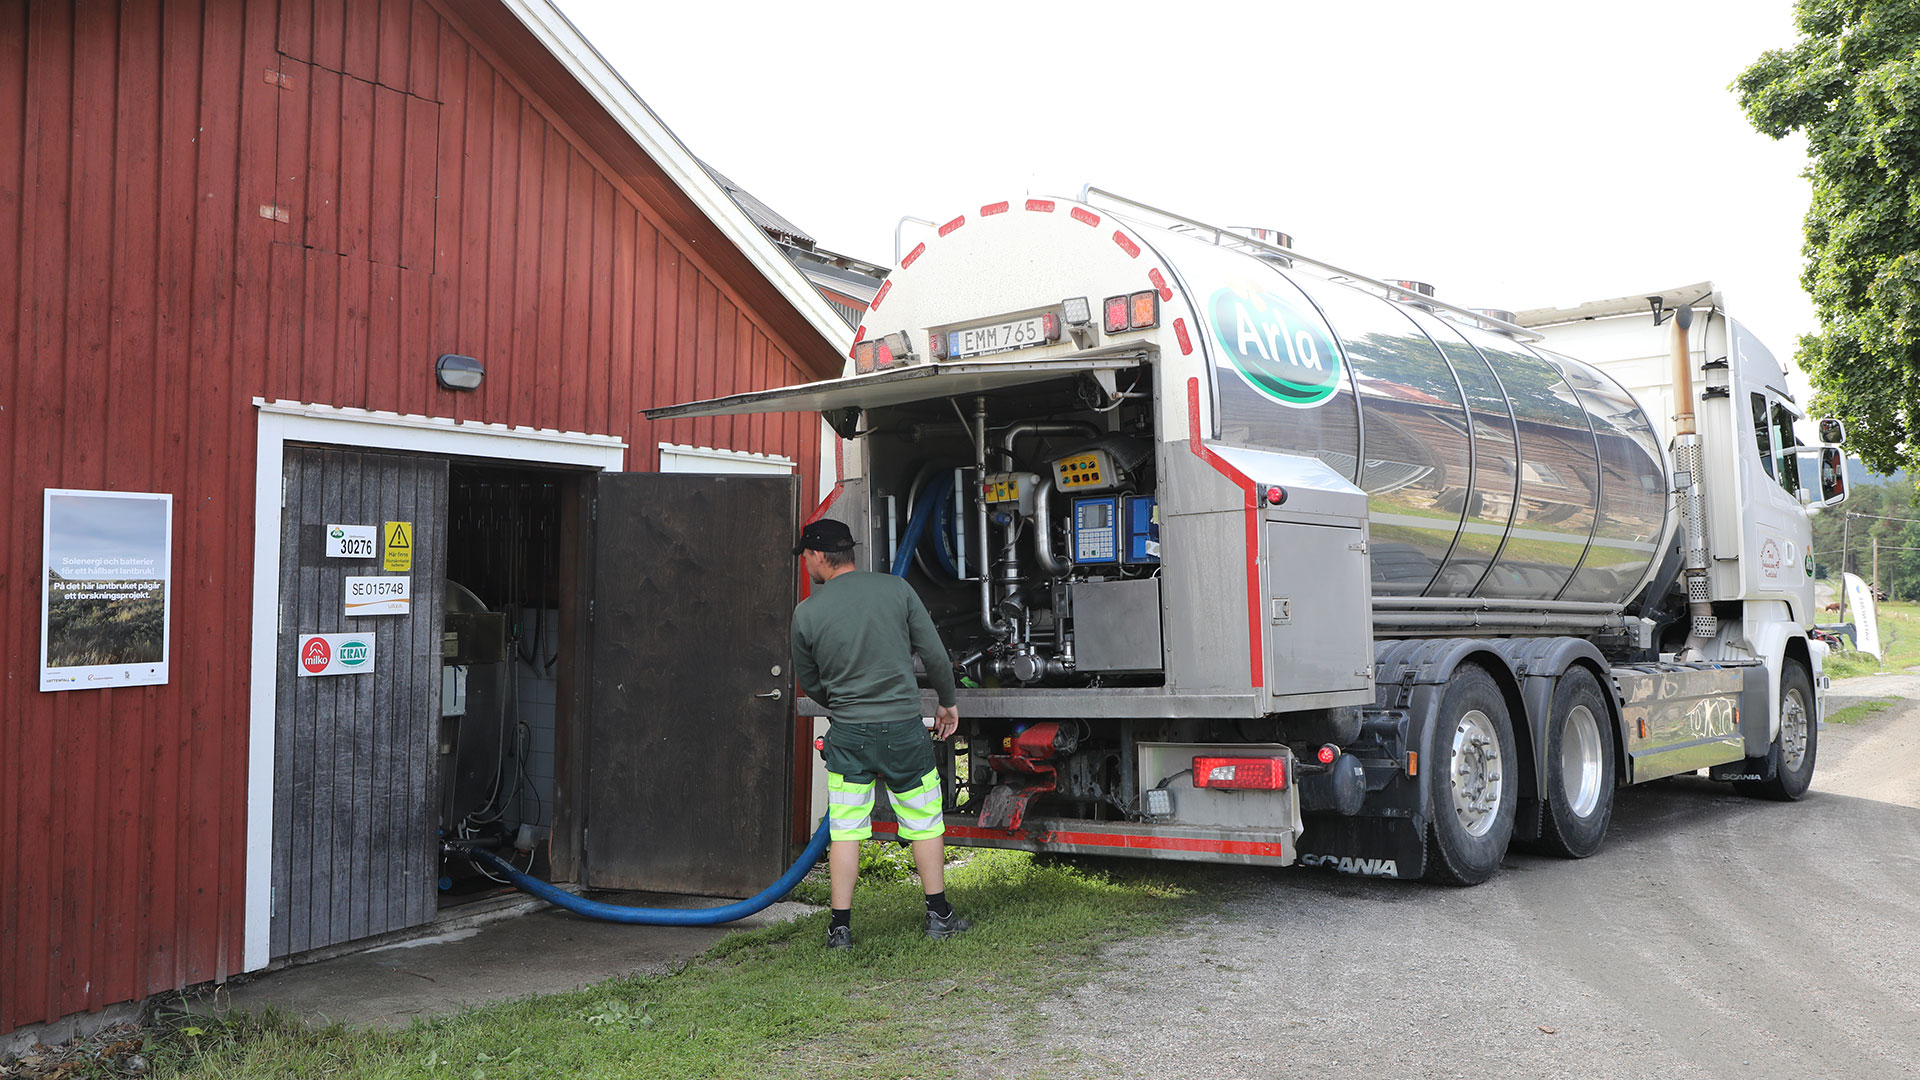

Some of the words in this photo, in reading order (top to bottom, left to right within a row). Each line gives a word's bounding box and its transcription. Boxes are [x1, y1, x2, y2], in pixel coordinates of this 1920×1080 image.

[965, 327, 997, 352] EMM
[1002, 321, 1036, 345] 765
[1234, 301, 1323, 372] Arla
[340, 538, 372, 555] 30276
[62, 557, 102, 567] Solenergi
[104, 557, 119, 565] och
[120, 557, 154, 565] batterier
[61, 567, 74, 575] för
[75, 567, 87, 575] ett
[88, 566, 119, 575] hållbart
[120, 567, 155, 575] lantbruk!
[54, 582, 65, 590] På
[66, 582, 80, 590] det
[81, 581, 95, 590] här
[96, 582, 137, 590] lantbruket
[138, 581, 161, 592] pågår
[352, 583, 364, 596] SE
[365, 582, 404, 596] 015748
[64, 592, 76, 600] ett
[77, 591, 151, 601] forskningsprojekt.
[340, 648, 367, 659] KRAV
[305, 655, 328, 665] milko
[1722, 773, 1762, 781] SCANIA
[1301, 853, 1399, 878] SCANIA
